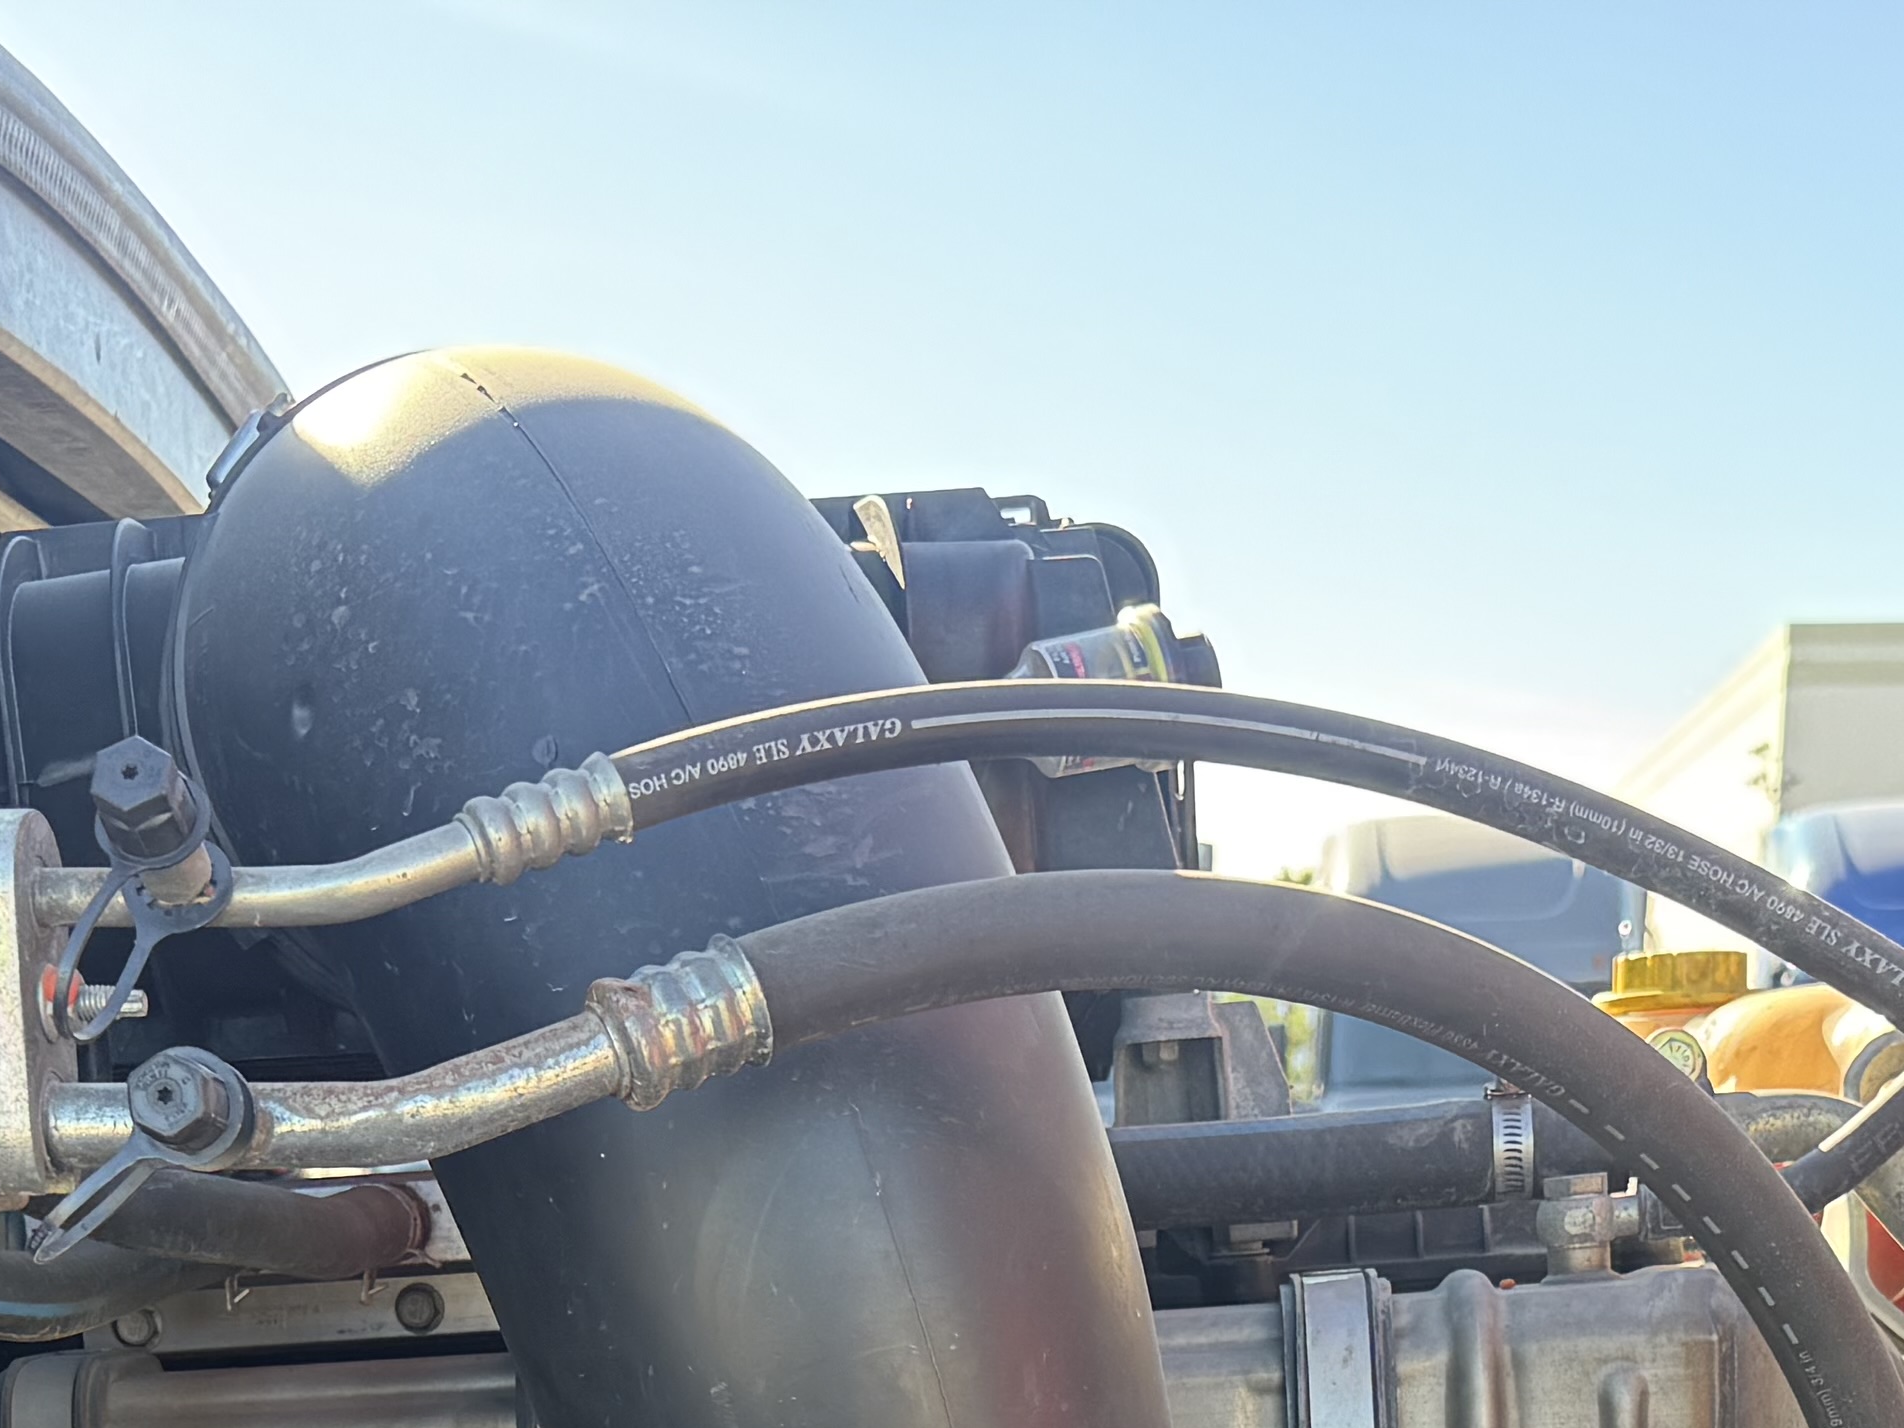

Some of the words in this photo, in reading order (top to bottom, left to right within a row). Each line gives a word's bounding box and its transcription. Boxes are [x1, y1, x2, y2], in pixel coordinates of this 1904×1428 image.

[793, 716, 904, 754] GALAXY
[705, 749, 749, 775] 4890
[751, 737, 790, 765] SLE
[669, 760, 703, 786] A/C
[1434, 755, 1501, 789] R-1234yf
[1513, 780, 1566, 811] R-134a
[1568, 800, 1626, 836] (10mm)
[1627, 827, 1643, 844] in
[1640, 832, 1688, 865] 13/32
[1684, 852, 1736, 888] HOSE
[1731, 876, 1767, 904] A/C
[1764, 894, 1805, 925] 4890
[1803, 915, 1842, 947] SLE
[1796, 1348, 1813, 1365] in
[1804, 1363, 1825, 1387] 3/4
